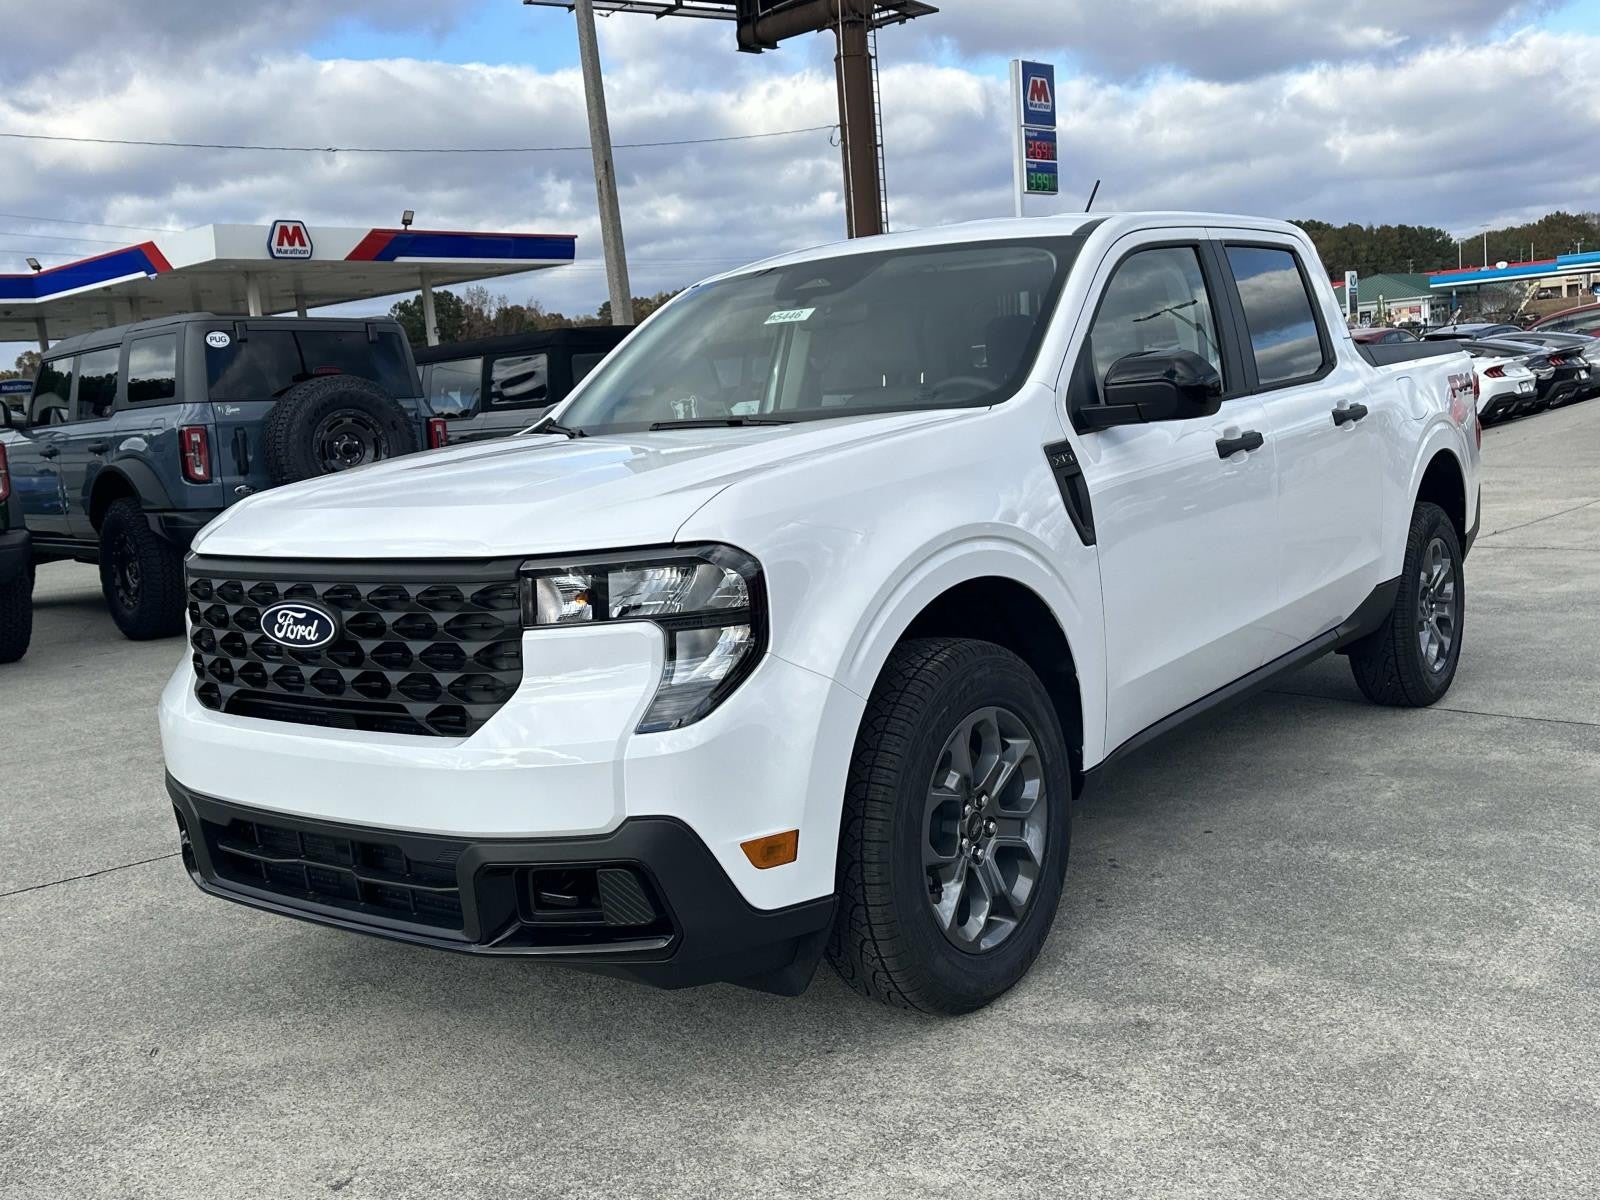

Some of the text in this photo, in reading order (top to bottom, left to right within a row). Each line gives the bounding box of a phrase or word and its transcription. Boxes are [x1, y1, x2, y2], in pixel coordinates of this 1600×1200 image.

[1030, 79, 1050, 102] M
[1029, 102, 1051, 110] Marathon
[277, 225, 306, 247] M
[274, 610, 319, 641] Ford
